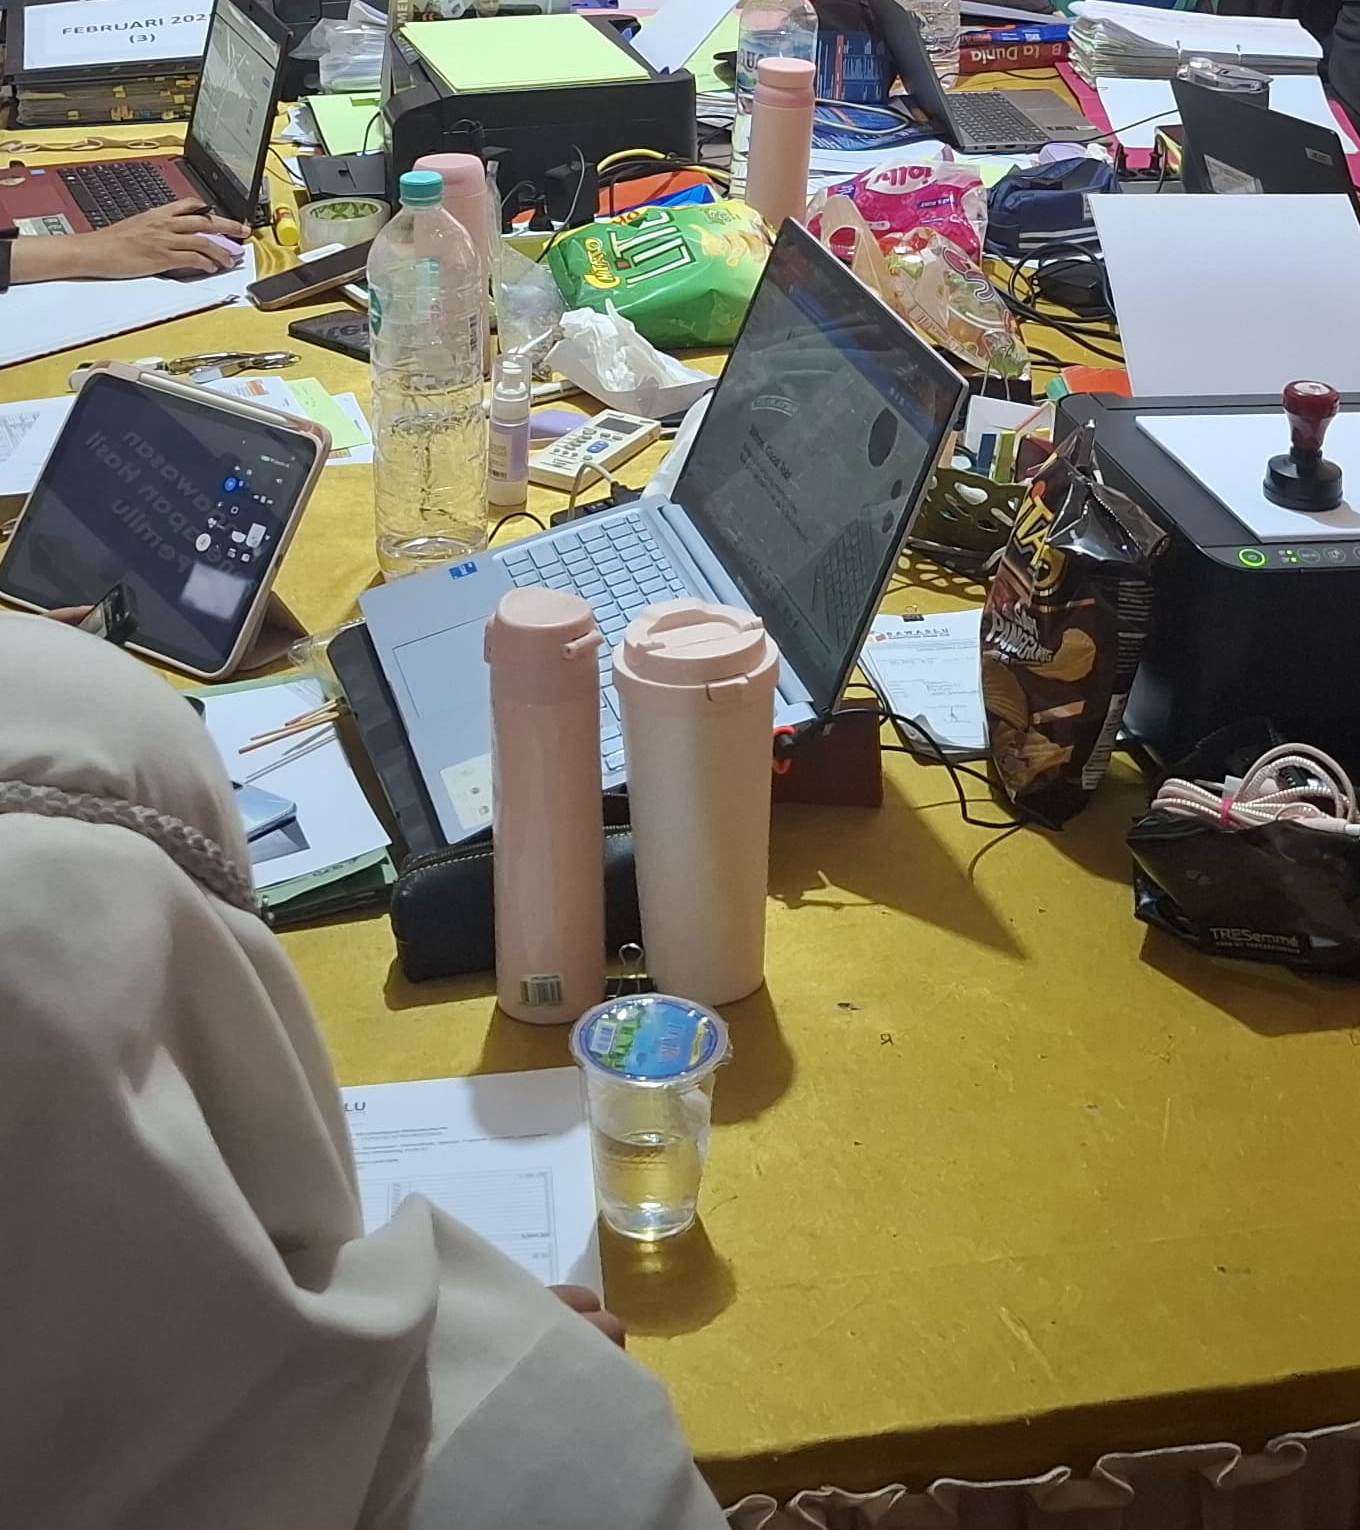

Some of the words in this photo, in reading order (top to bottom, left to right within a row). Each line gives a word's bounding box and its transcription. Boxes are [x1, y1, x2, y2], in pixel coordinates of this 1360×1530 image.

[61, 17, 165, 37] FEBRUARI
[169, 13, 210, 27] 202
[129, 32, 156, 46] (3)
[969, 44, 1019, 63] Dunia
